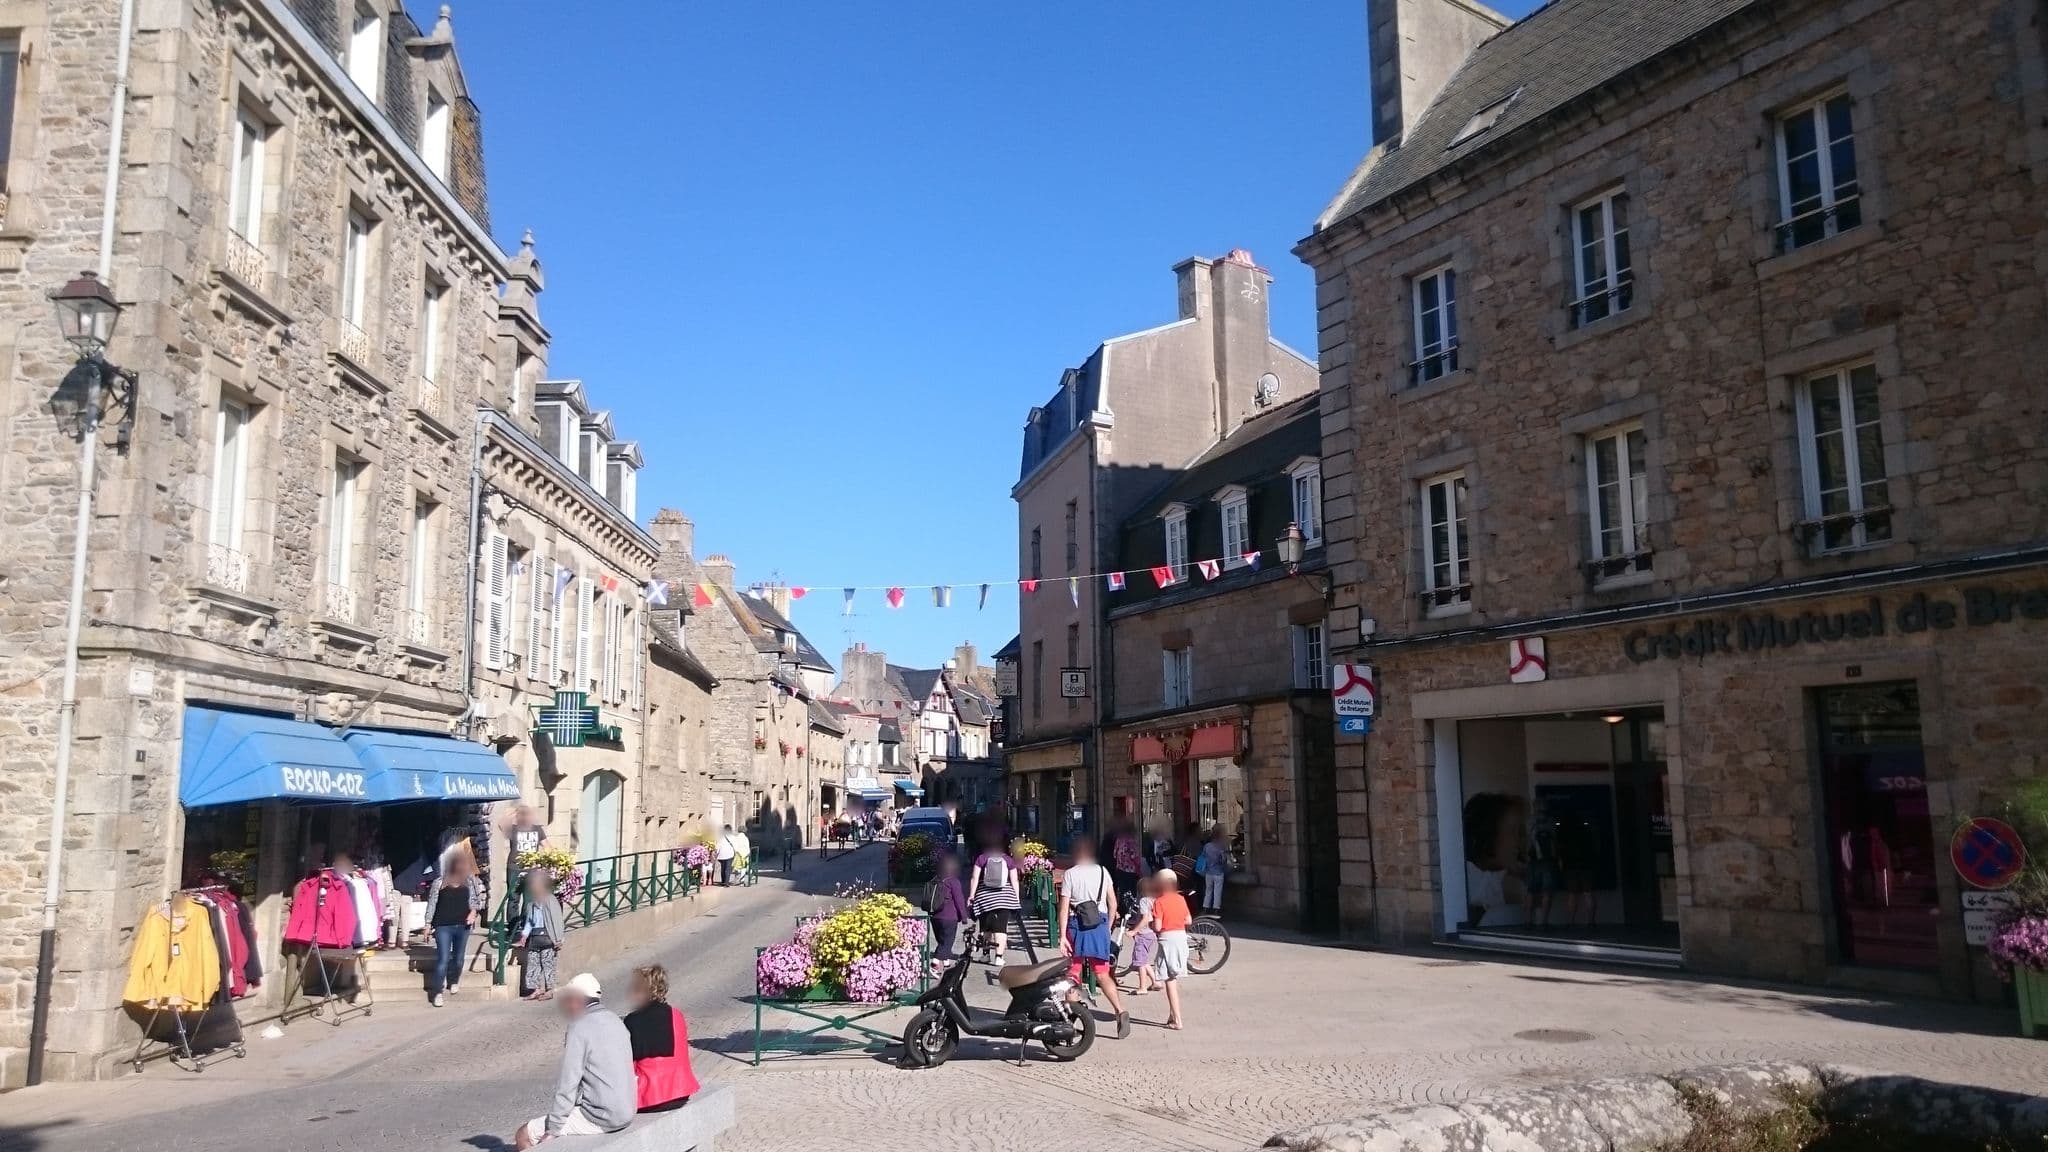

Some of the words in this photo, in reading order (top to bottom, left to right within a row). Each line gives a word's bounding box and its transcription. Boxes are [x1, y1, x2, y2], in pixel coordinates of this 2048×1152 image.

[1624, 618, 1731, 664] Crédit
[1737, 597, 1885, 653] Mutuel
[1895, 591, 1957, 634] de
[1347, 705, 1369, 713] Bretagne
[281, 766, 365, 797] ROSKO-GOZ
[445, 775, 457, 795] La
[458, 776, 487, 796] Maison
[488, 777, 498, 795] du
